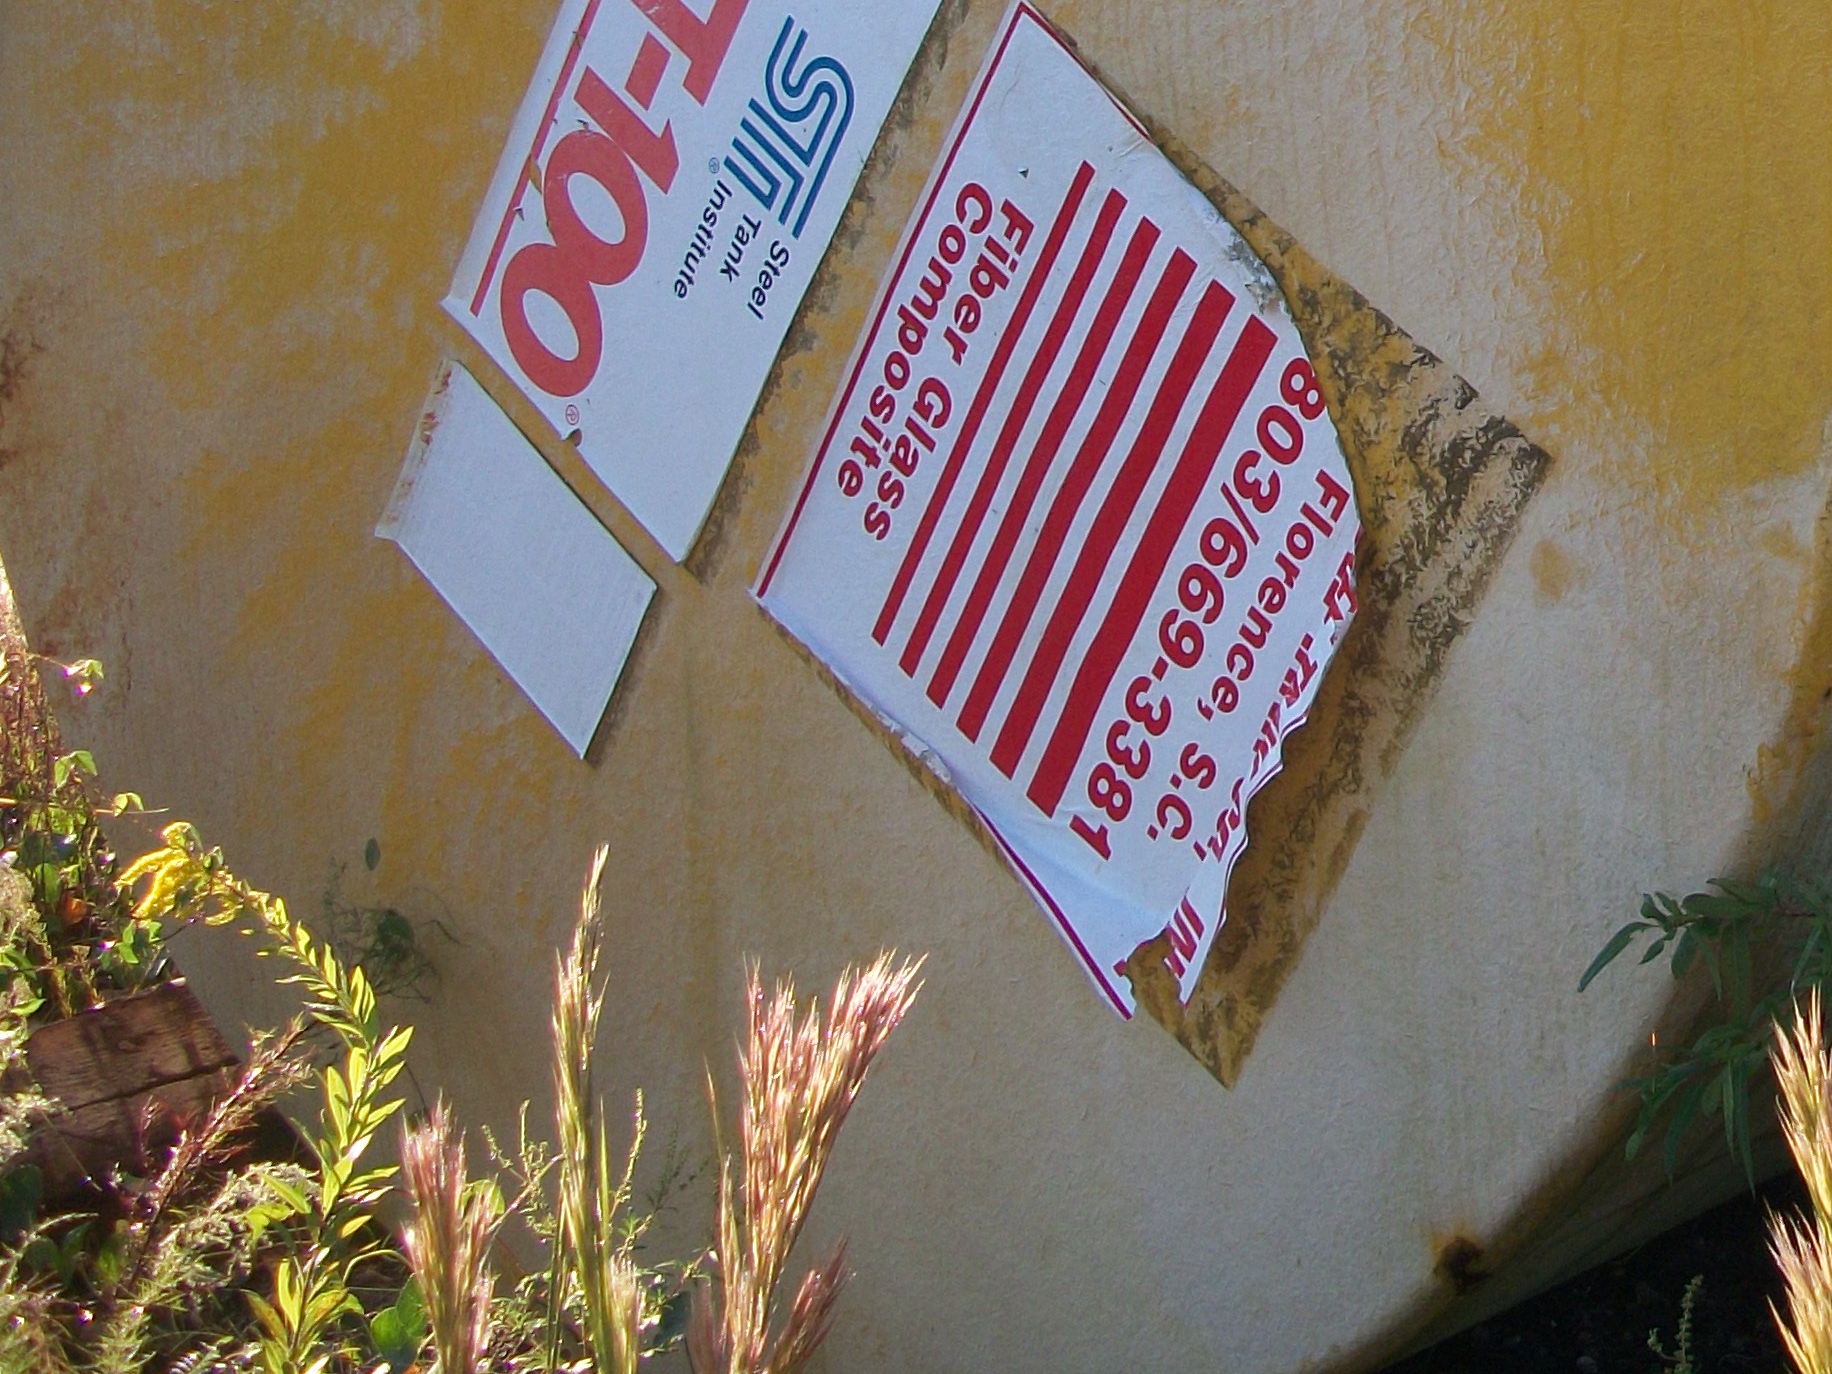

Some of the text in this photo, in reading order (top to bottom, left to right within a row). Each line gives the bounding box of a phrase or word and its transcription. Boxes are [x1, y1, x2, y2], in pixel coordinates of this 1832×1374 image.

[674, 179, 733, 299] Institute
[719, 213, 762, 283] Tank
[747, 240, 790, 321] Steel
[838, 182, 993, 497] Composite
[863, 198, 1035, 541] Fiber Glass
[1068, 357, 1326, 861] 803/669-3381
[1197, 468, 1351, 722] Florence,
[1147, 741, 1217, 841] S.C.
